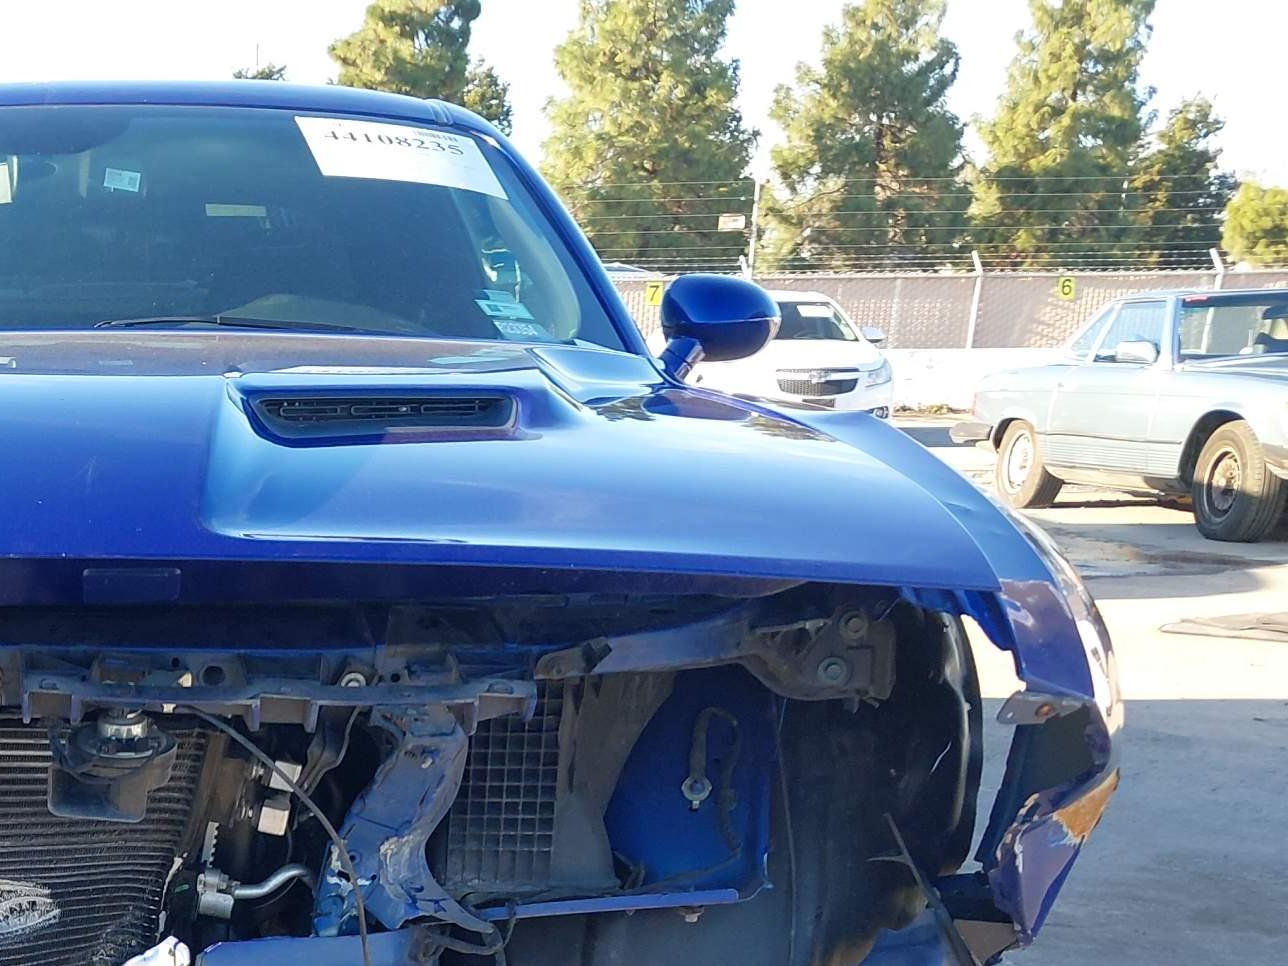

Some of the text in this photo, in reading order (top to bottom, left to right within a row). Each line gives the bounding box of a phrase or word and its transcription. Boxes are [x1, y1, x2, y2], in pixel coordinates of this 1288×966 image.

[324, 130, 465, 156] 44108235
[648, 285, 661, 302] 7
[1061, 278, 1073, 296] 6
